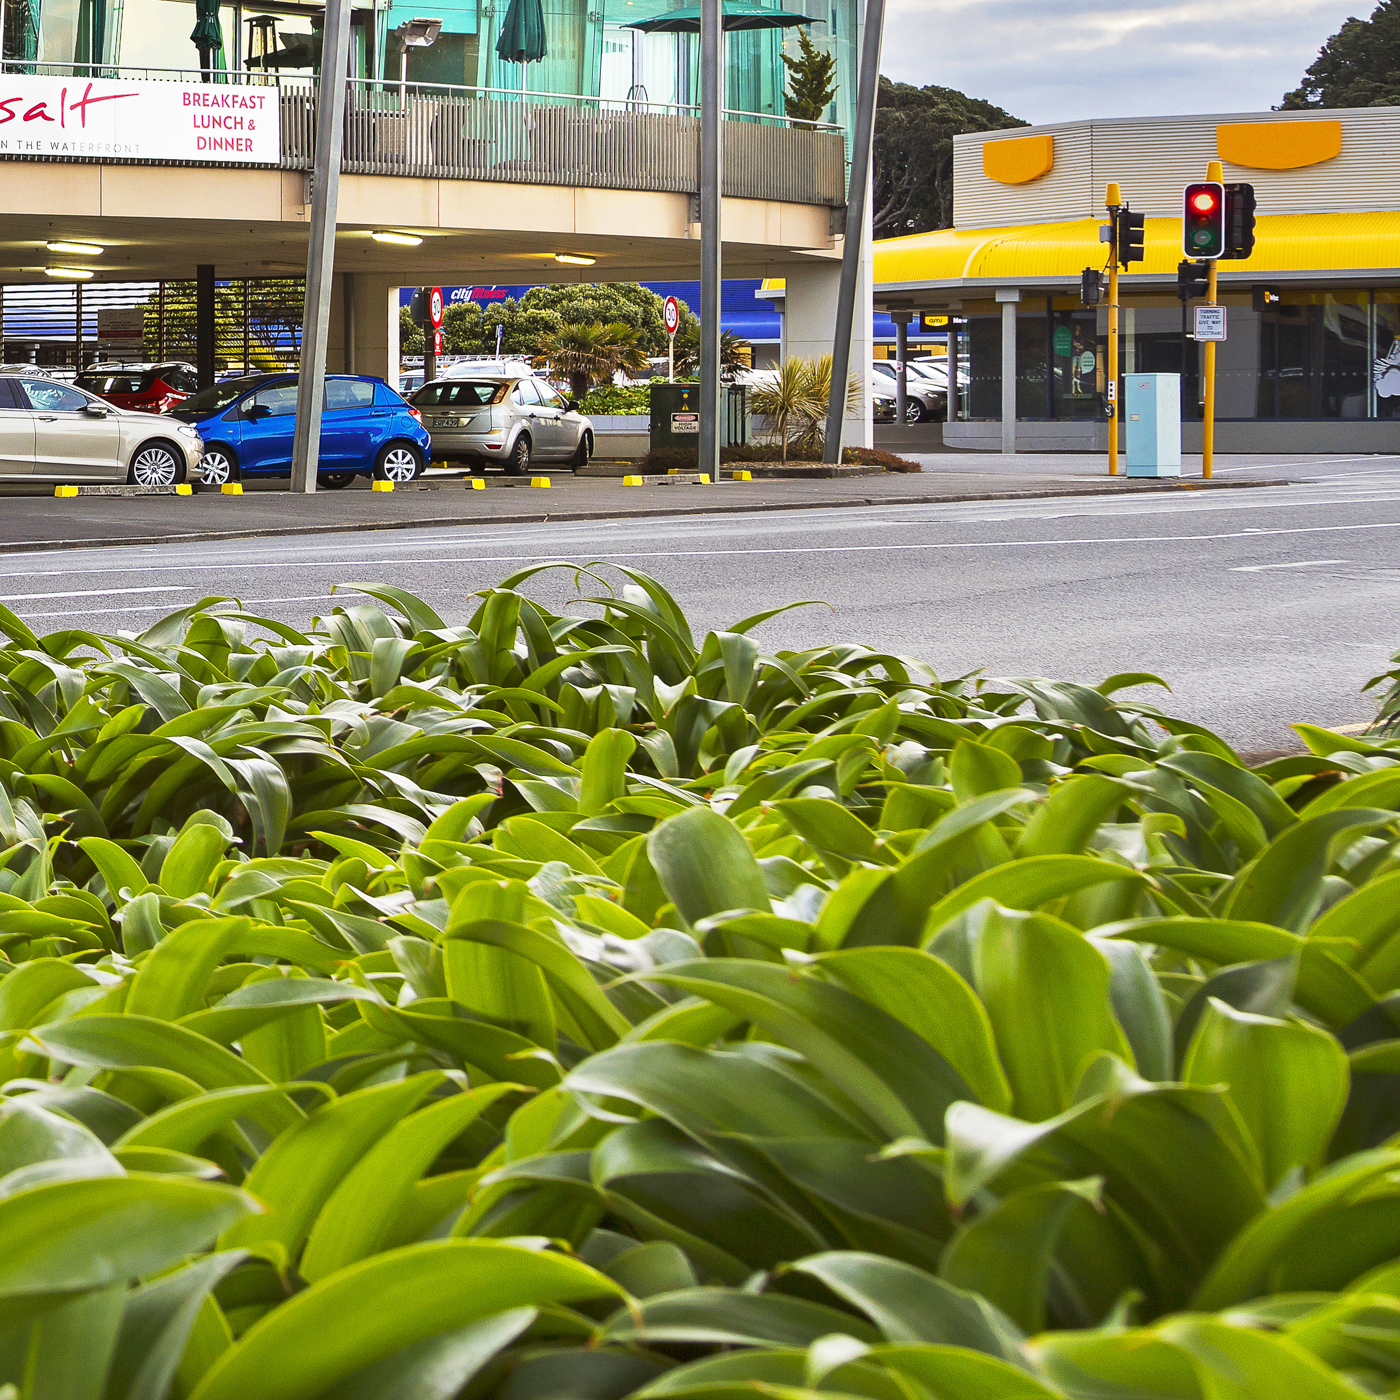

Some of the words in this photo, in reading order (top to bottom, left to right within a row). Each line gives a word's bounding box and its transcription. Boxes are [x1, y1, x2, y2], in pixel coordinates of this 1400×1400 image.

[182, 92, 266, 110] BREAKFAST
[192, 114, 244, 131] LUNCH
[248, 119, 256, 131] &
[16, 140, 42, 150] THE
[50, 140, 142, 154] WATERFRONT
[196, 136, 254, 152] DINNER
[667, 308, 676, 321] 30
